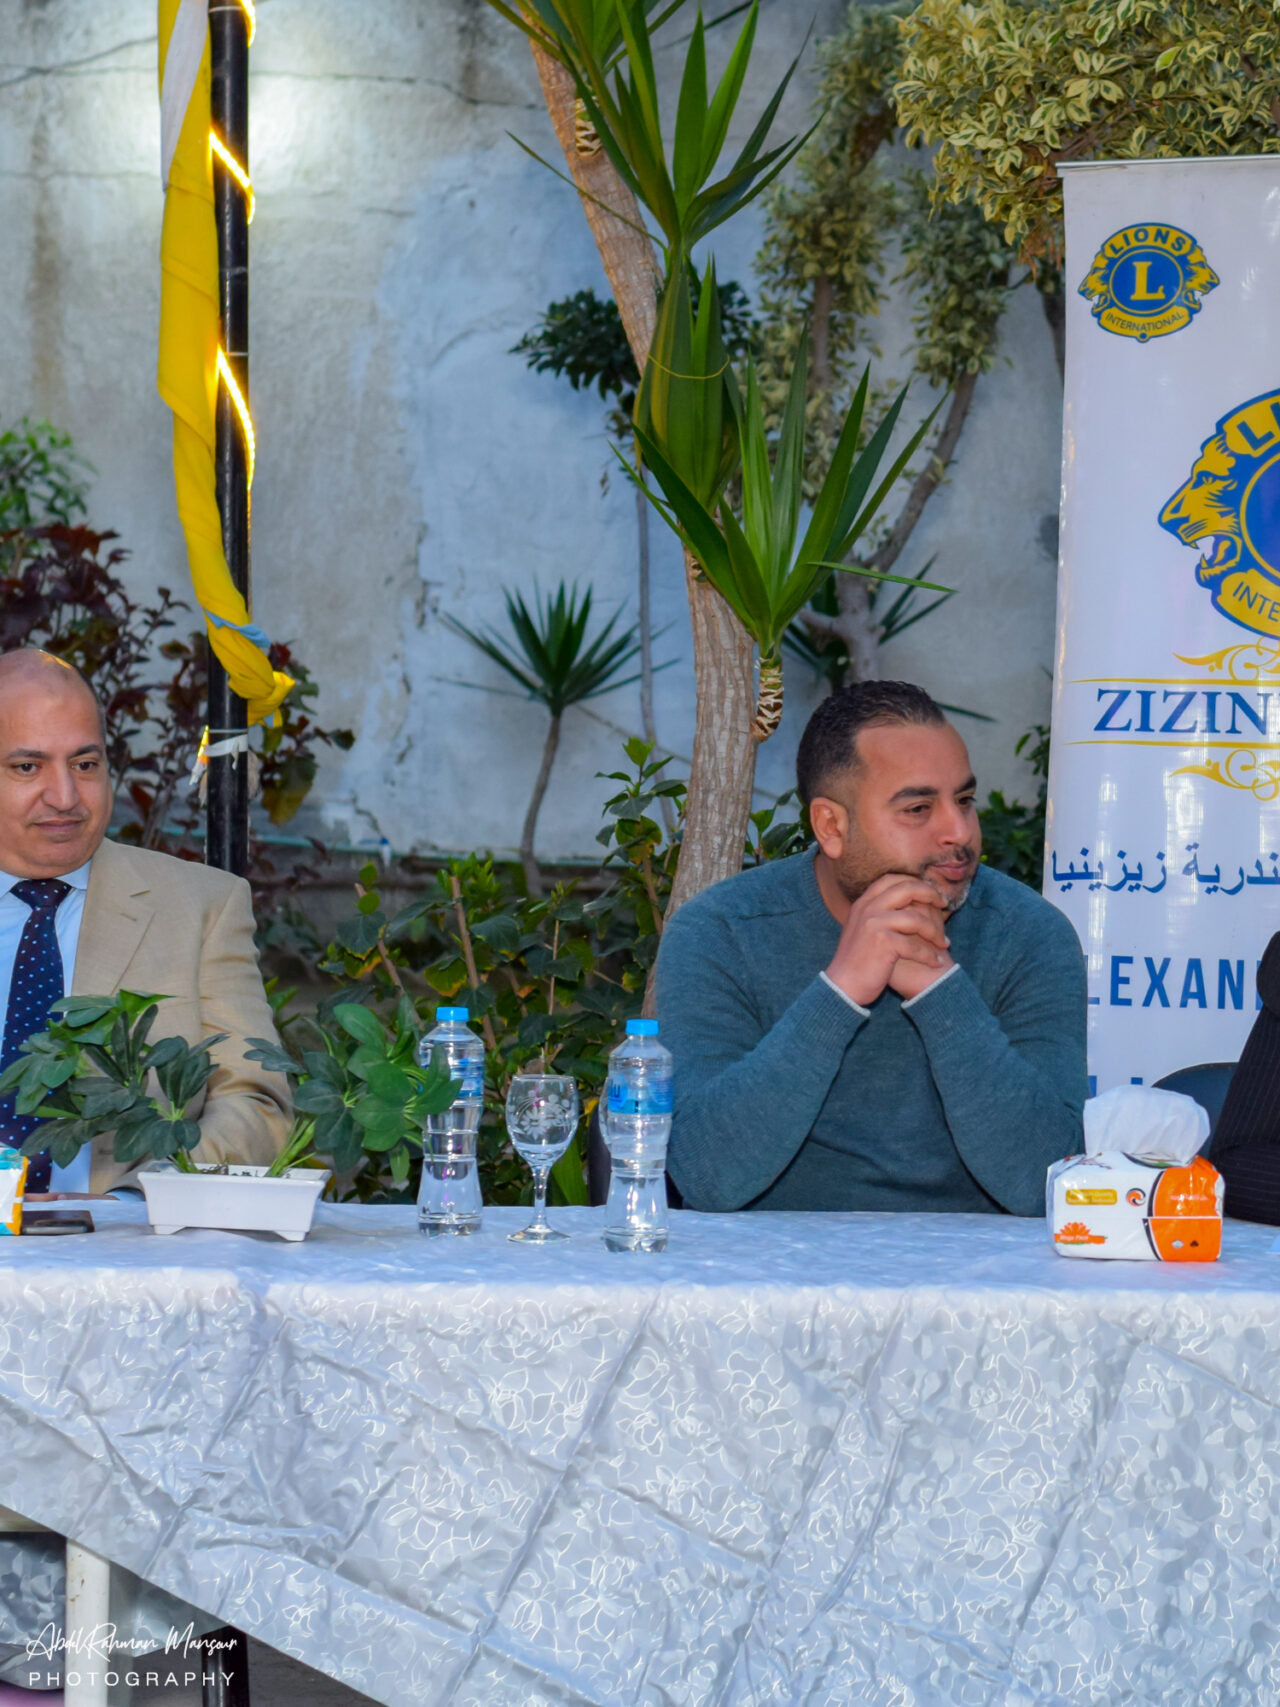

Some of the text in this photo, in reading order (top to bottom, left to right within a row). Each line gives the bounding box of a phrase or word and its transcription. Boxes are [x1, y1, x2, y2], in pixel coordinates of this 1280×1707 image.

[1109, 227, 1186, 255] LIONS
[1130, 261, 1166, 300] L
[1105, 311, 1185, 332] INTERNATIONAL
[1051, 846, 1167, 893] زيزينيا
